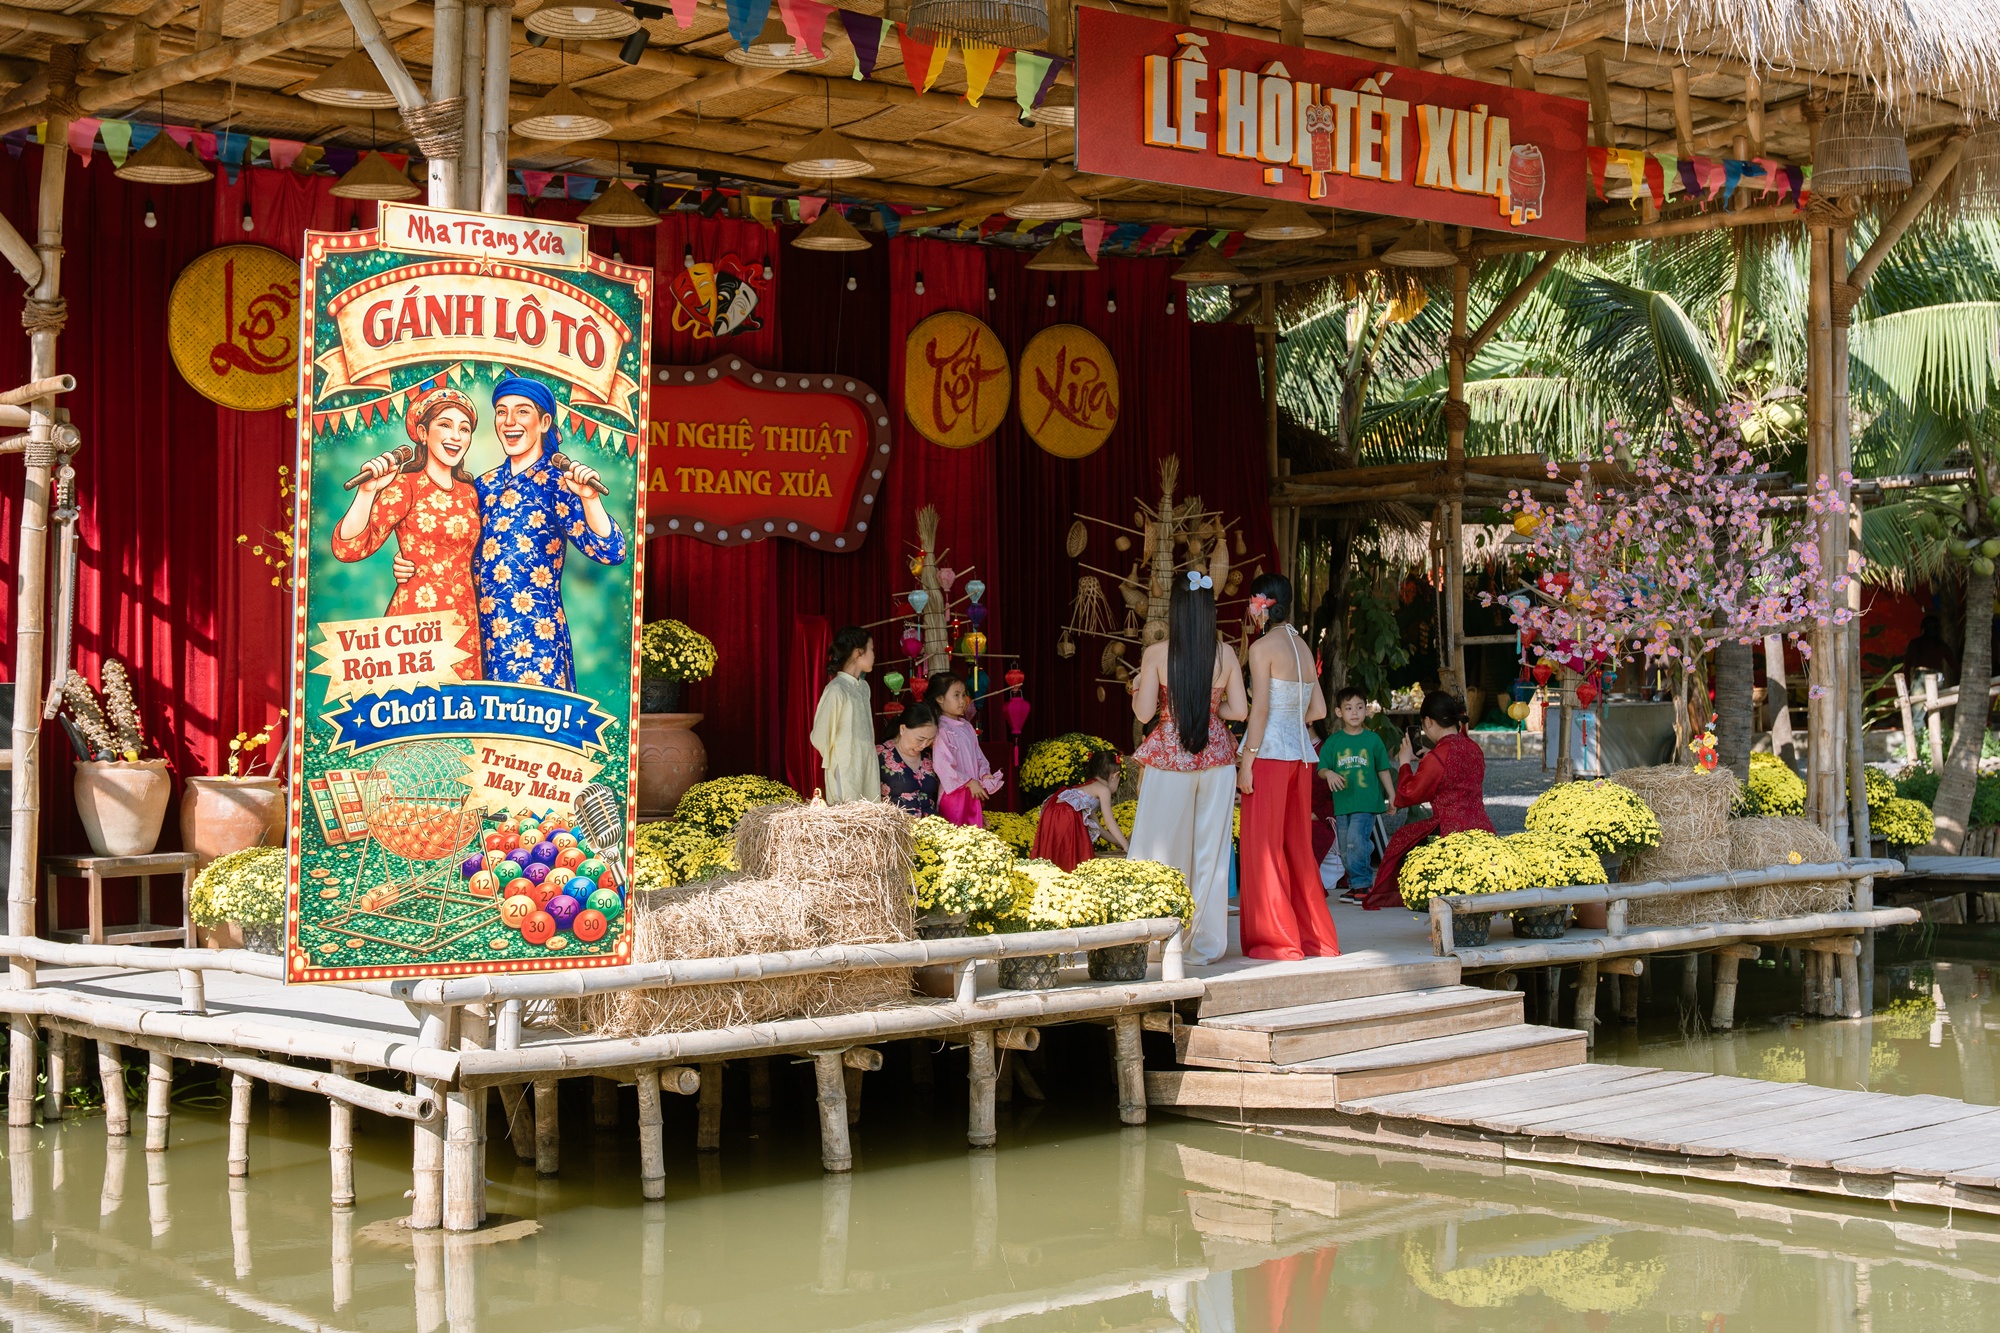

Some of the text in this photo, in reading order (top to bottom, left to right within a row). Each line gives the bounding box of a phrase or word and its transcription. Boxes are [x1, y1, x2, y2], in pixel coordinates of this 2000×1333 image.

[1144, 32, 1512, 198] LỄ HỘI TẾT XƯA
[408, 213, 566, 256] Nha Trang Xưa
[362, 285, 606, 369] GÁNH LÔ TÔ
[648, 417, 854, 461] N NGHỆ THUẬT
[647, 466, 834, 498] A TRANG XƯA
[336, 619, 443, 652] Vui Cười
[342, 649, 436, 686] Rộn Rã
[369, 694, 573, 734] Chơi Là Trúng!
[481, 747, 584, 784] Trúng Quà
[1338, 756, 1368, 767] ADVENTURE
[483, 771, 526, 798] May
[504, 824, 516, 833] 24
[503, 842, 516, 850] 60
[523, 836, 537, 845] 50
[558, 838, 571, 848] 82
[538, 847, 551, 857] 45
[466, 859, 479, 869] 90
[562, 857, 576, 868] 50
[501, 868, 515, 879] 36
[530, 868, 545, 880] 45
[586, 866, 600, 877] 36
[476, 879, 490, 890] 12
[554, 875, 569, 885] 60
[513, 887, 527, 896] 24
[541, 891, 555, 902] 22
[574, 887, 588, 898] 70
[597, 898, 612, 909] 90
[509, 904, 528, 918] 20
[555, 905, 573, 919] 24
[528, 921, 545, 933] 30
[584, 919, 600, 931] 90
